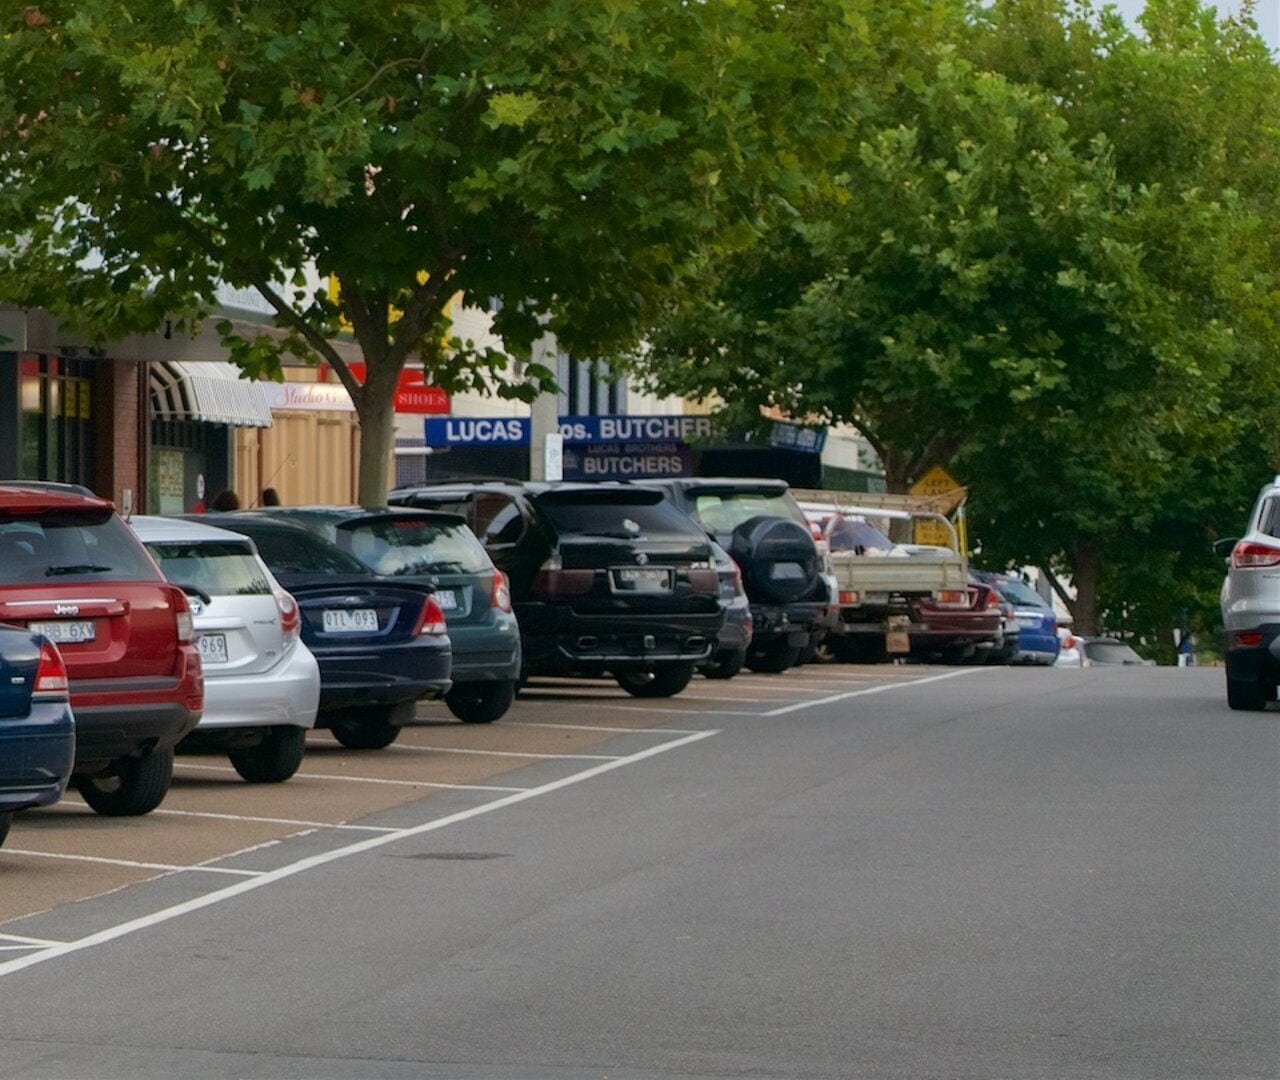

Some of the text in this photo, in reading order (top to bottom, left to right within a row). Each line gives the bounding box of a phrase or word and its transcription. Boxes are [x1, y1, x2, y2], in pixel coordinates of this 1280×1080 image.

[275, 386, 322, 407] Studio
[398, 392, 447, 406] SHOES
[446, 421, 522, 441] LUCAS
[589, 444, 677, 453] LUCAS BROTHERS
[584, 456, 683, 474] BUTCHERS
[53, 604, 79, 615] Jeep
[202, 637, 224, 653] 969
